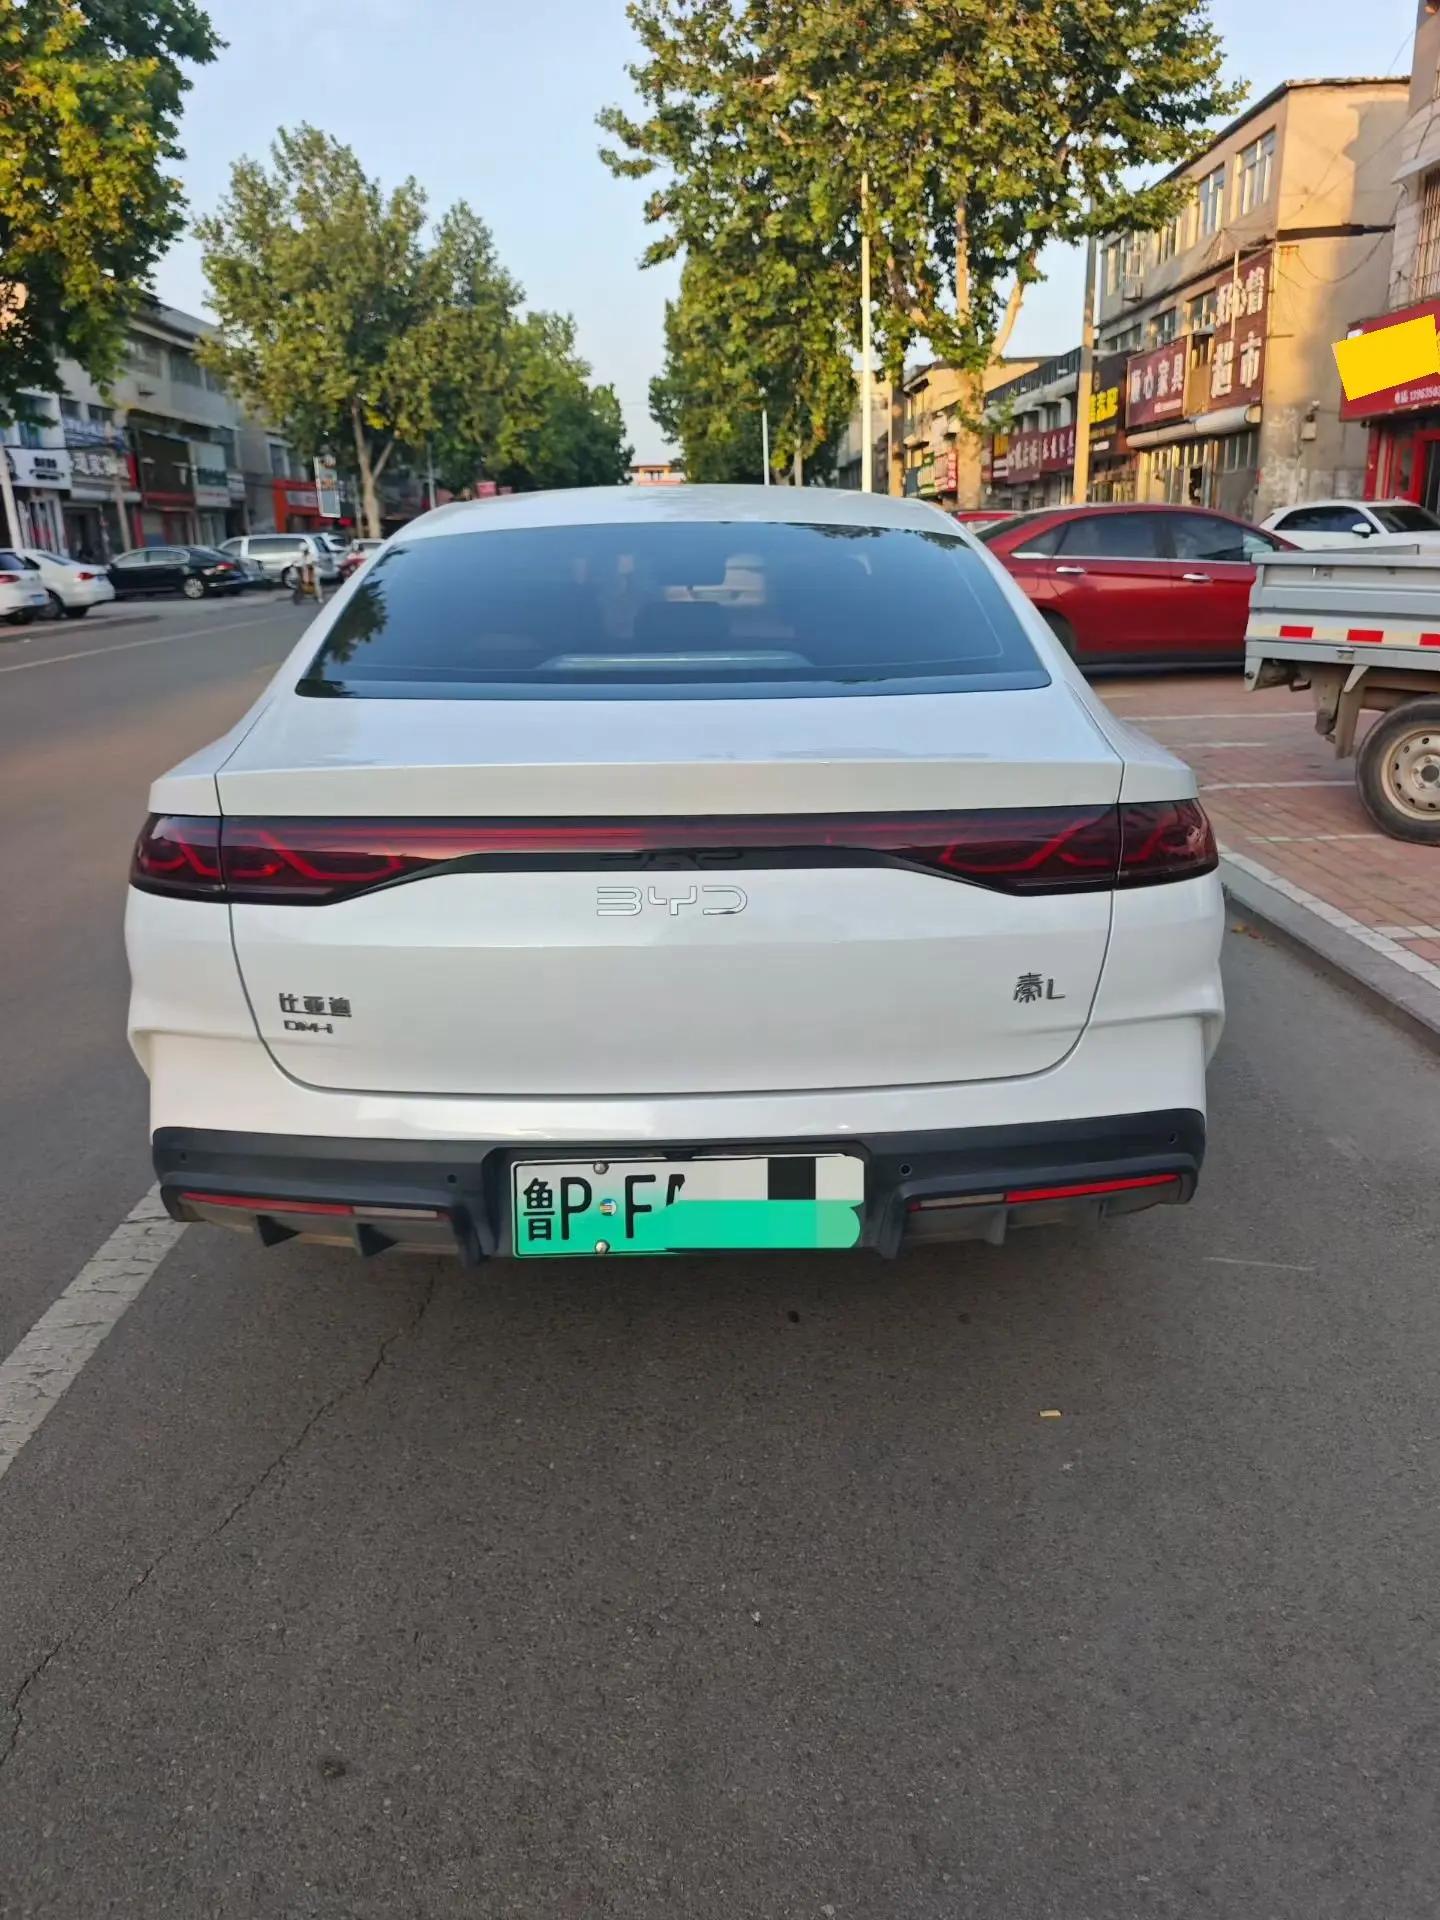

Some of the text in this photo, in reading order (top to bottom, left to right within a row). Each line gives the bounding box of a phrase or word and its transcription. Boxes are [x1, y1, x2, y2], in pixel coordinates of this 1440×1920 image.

[1211, 331, 1262, 398] 超市
[597, 885, 748, 916] BYD
[1013, 972, 1066, 1003] 秦L
[279, 992, 352, 1017] 比亚迪
